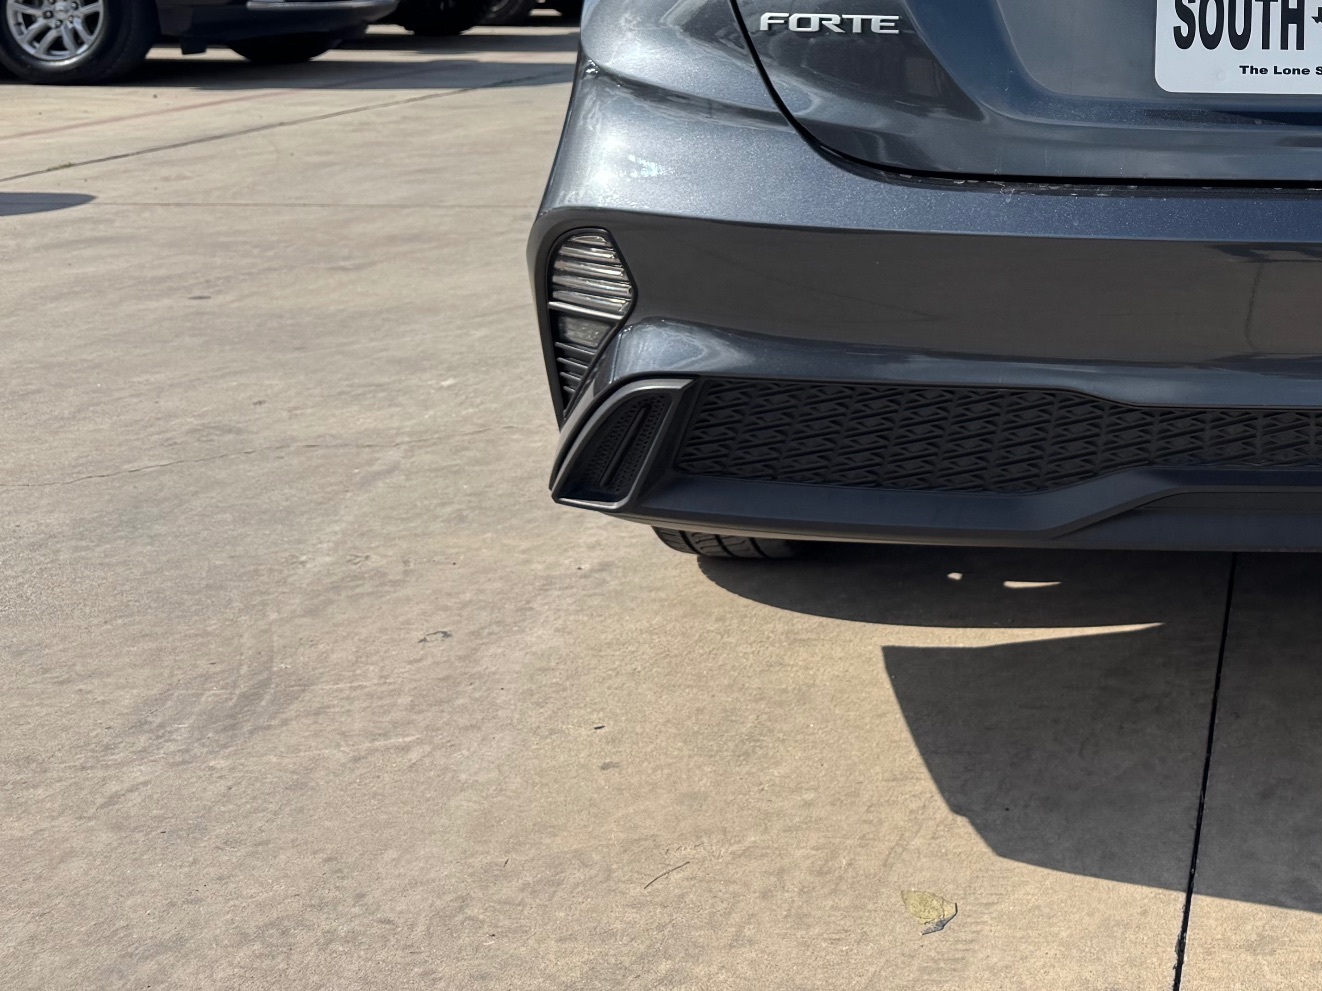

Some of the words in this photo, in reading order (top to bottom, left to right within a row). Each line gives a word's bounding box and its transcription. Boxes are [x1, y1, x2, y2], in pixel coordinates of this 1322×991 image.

[760, 12, 900, 34] FORTE
[1239, 65, 1268, 75] The
[1273, 65, 1311, 76] Lone
